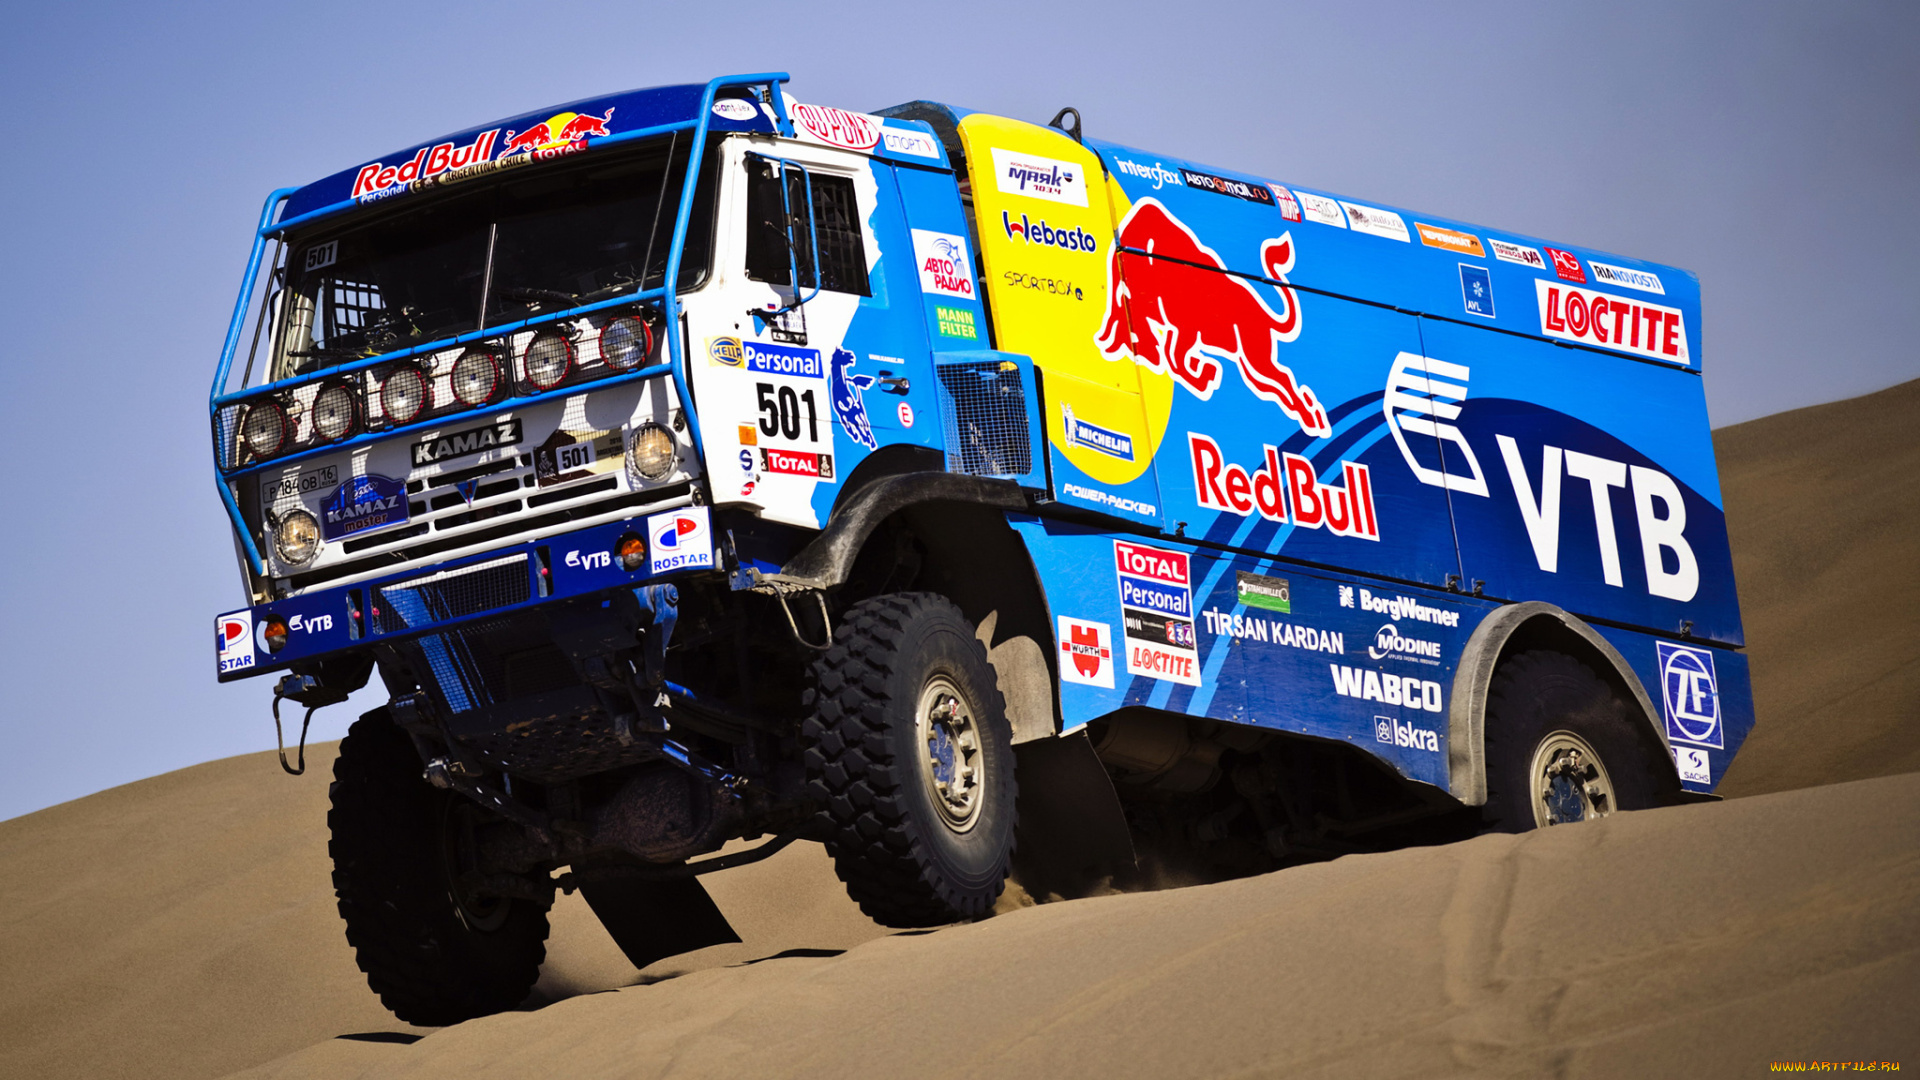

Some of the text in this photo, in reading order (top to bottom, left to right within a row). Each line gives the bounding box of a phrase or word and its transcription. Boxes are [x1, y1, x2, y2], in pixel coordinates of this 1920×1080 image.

[535, 143, 586, 160] TOTAL
[885, 134, 921, 151] СПОРТ
[352, 128, 500, 198] Red Bull
[445, 153, 526, 183] ARGENTINA CHILE
[1113, 155, 1183, 190] interfax
[360, 182, 407, 204] Personal
[1034, 184, 1061, 195] 103.4
[1002, 209, 1096, 253] Webasto
[307, 243, 334, 268] 501
[924, 257, 954, 276] АВТО
[1551, 249, 1579, 270] AG
[934, 273, 972, 294] РАДИО
[1004, 271, 1074, 296] SPORTBOX
[936, 307, 973, 325] MANN
[1467, 300, 1482, 312] AVL
[939, 321, 977, 339] FILTER
[1545, 287, 1679, 356] LOCTITE
[713, 346, 742, 359] HELLA
[744, 345, 820, 376] Personal
[756, 382, 818, 443] 501
[901, 406, 911, 423] E
[415, 422, 517, 464] KAMAZ
[1078, 425, 1130, 454] MICHELIN
[561, 445, 590, 470] 501
[768, 452, 818, 473] TOTAL
[320, 467, 333, 480] 16
[1187, 431, 1380, 542] Red Bull
[327, 494, 399, 523] KAMAZ
[1063, 482, 1156, 517] POWER-PACKER
[344, 513, 388, 533] master
[1495, 433, 1700, 603] VTB
[581, 550, 611, 571] VTB
[653, 552, 709, 571] ROSTAR
[1118, 545, 1186, 581] TOTAL
[1123, 580, 1187, 613] Personal
[1360, 588, 1459, 627] BorgWarner
[304, 614, 333, 635] VTB
[1271, 621, 1344, 655] KARDAN
[1377, 633, 1441, 658] MODINE
[1133, 647, 1193, 678] LOCTITE
[1329, 663, 1442, 713] WABCO
[1667, 665, 1715, 724] ZF
[1392, 718, 1439, 752] Iskra
[1684, 771, 1709, 783] SACHS
